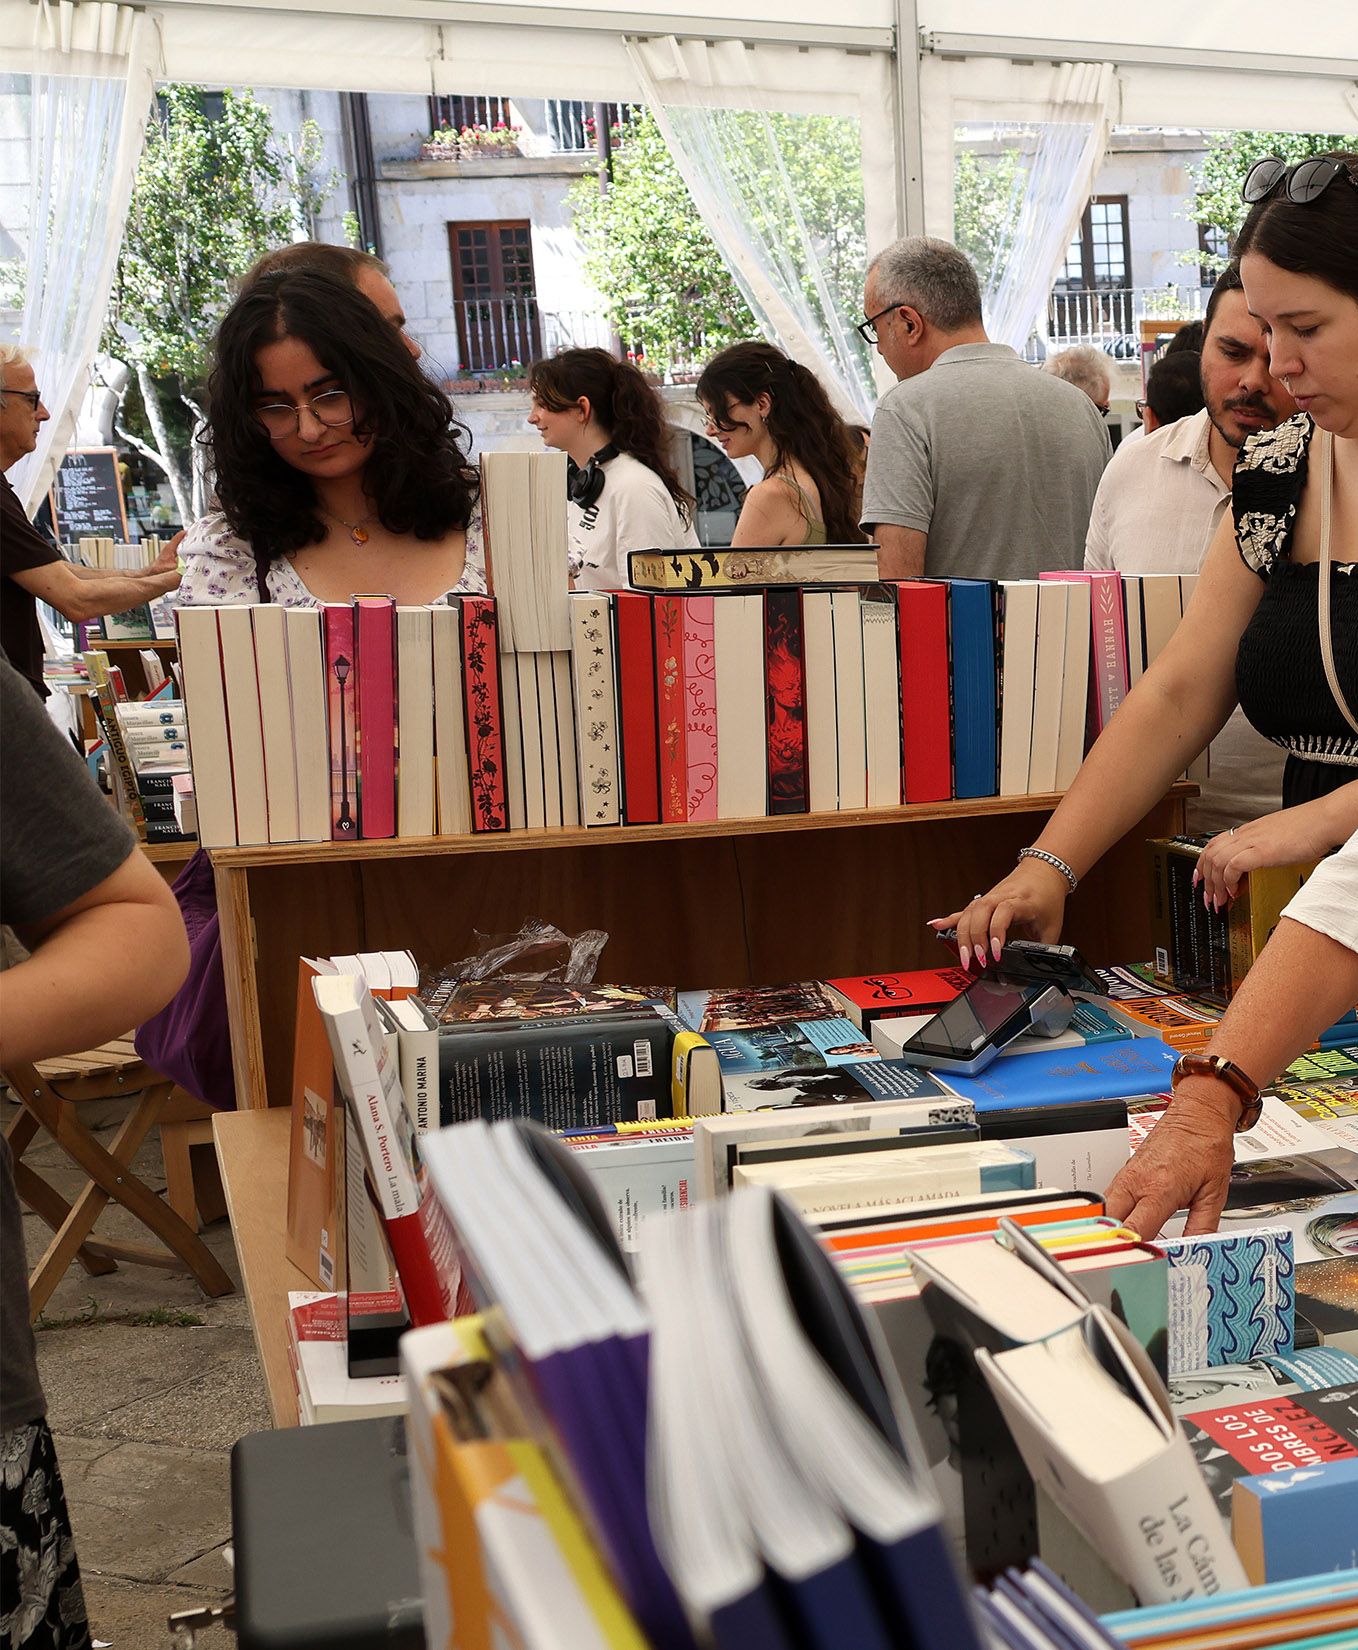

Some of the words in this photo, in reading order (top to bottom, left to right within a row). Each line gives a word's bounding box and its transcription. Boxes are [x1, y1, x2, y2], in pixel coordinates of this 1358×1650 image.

[1104, 618, 1116, 668] HANNAH
[105, 717, 126, 763] ANTIGUO
[120, 765, 137, 801] EGIPTO
[416, 1056, 427, 1091] MARINA
[366, 1093, 379, 1125] Alana
[417, 1094, 428, 1129] ANTONIO
[1306, 1088, 1344, 1107] Burke
[1308, 1103, 1338, 1121] Caro
[374, 1124, 383, 1134] S.
[648, 1136, 690, 1144] FREIDA
[377, 1135, 393, 1172] Portero
[388, 1175, 398, 1189] La
[389, 1189, 404, 1213] mala
[1214, 1414, 1258, 1439] LOS
[1243, 1408, 1277, 1424] DE
[1167, 1495, 1196, 1539] La
[1137, 1515, 1166, 1550] de
[1152, 1551, 1181, 1593] las
